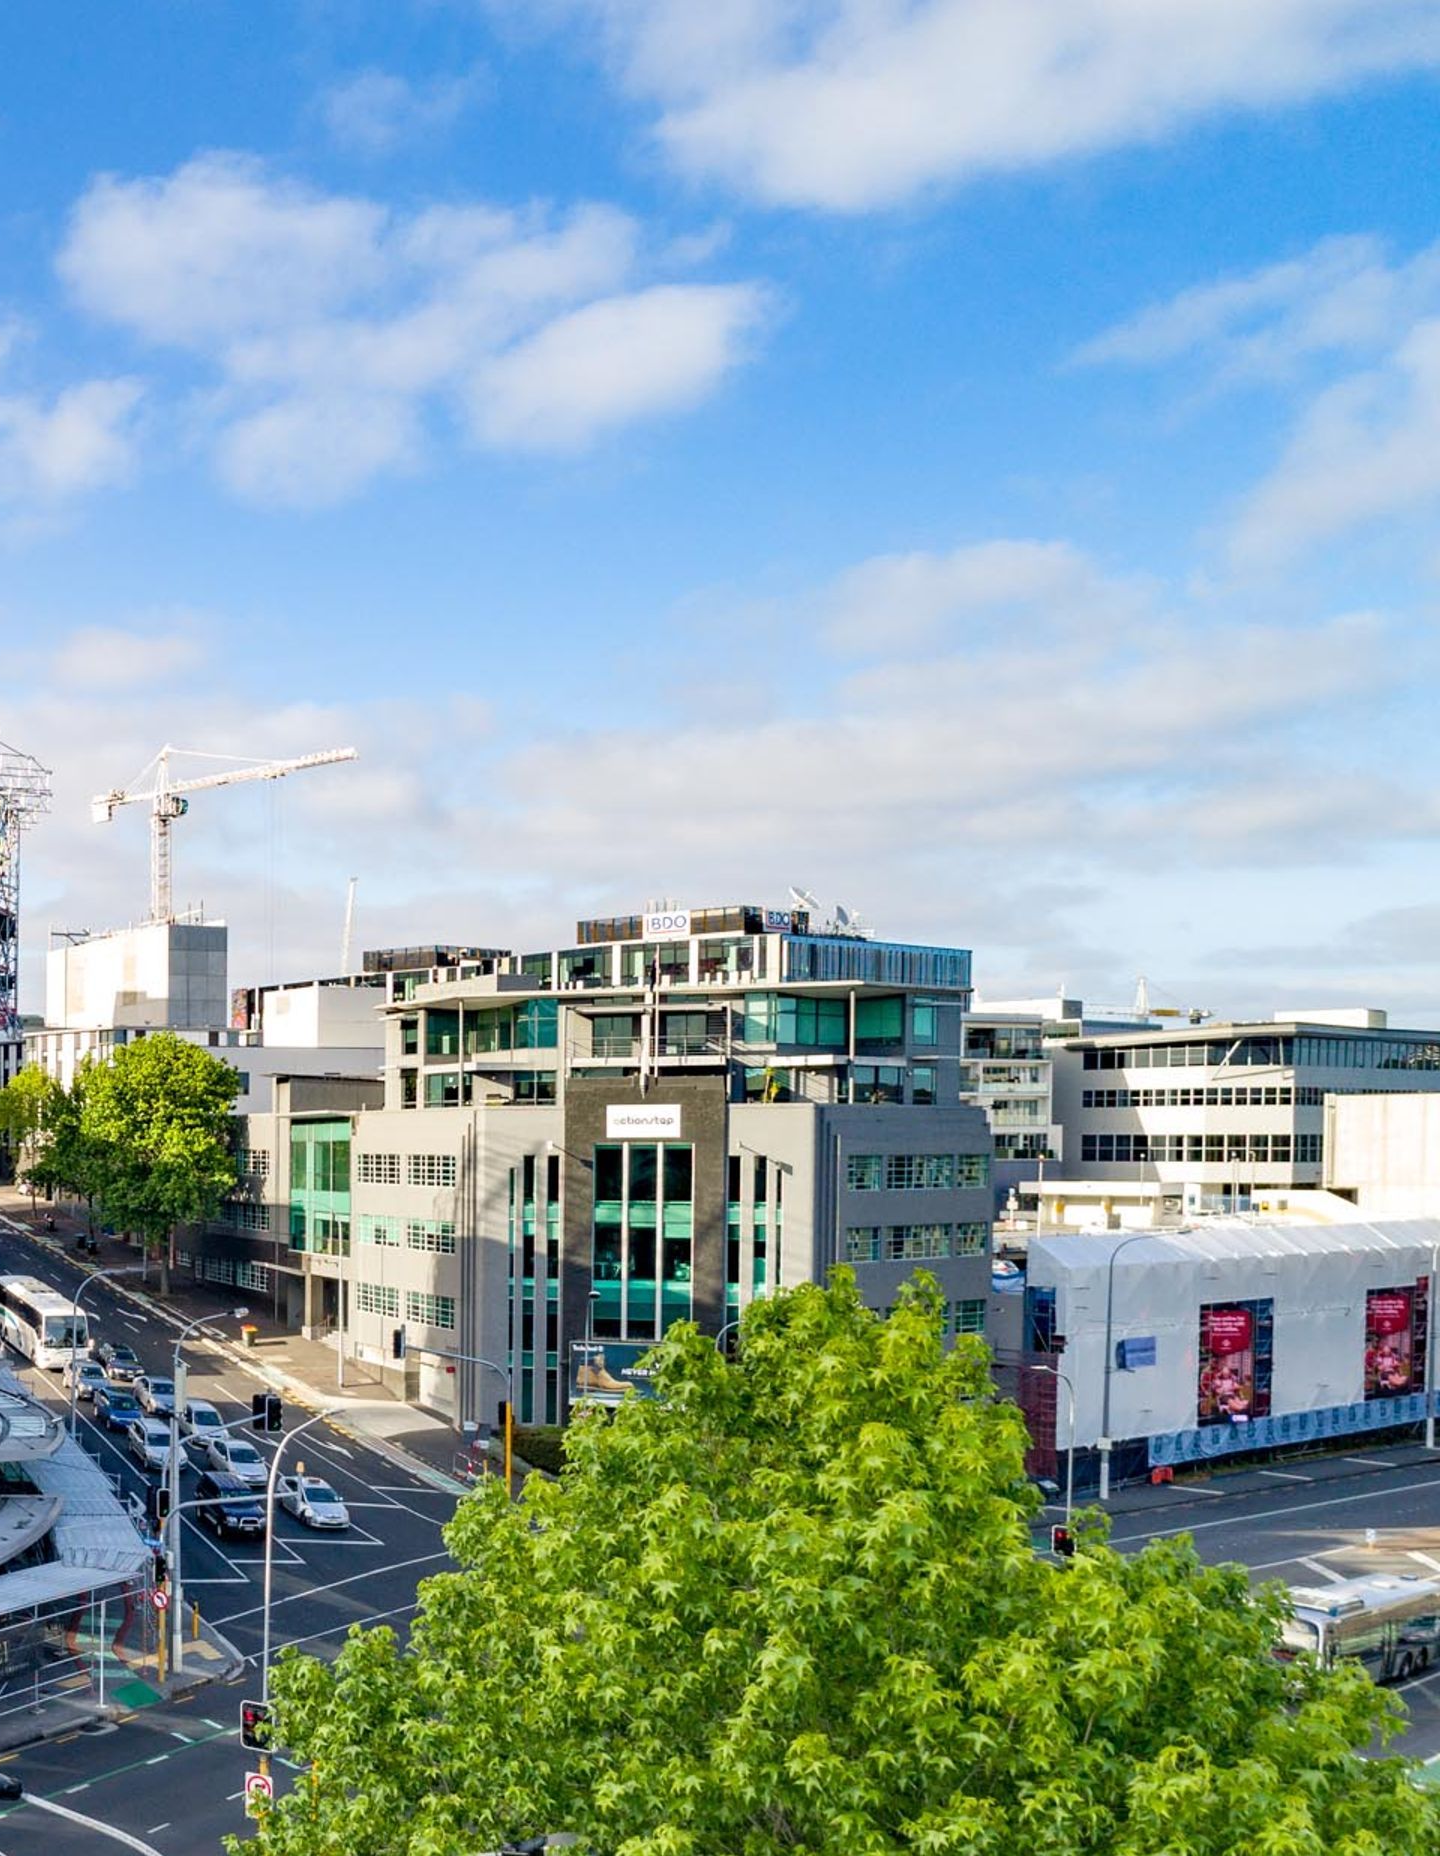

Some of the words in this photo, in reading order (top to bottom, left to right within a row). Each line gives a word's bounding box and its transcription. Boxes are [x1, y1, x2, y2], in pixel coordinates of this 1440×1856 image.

[651, 914, 687, 931] BDO
[768, 911, 790, 926] BDO
[621, 1367, 648, 1377] NEVER
